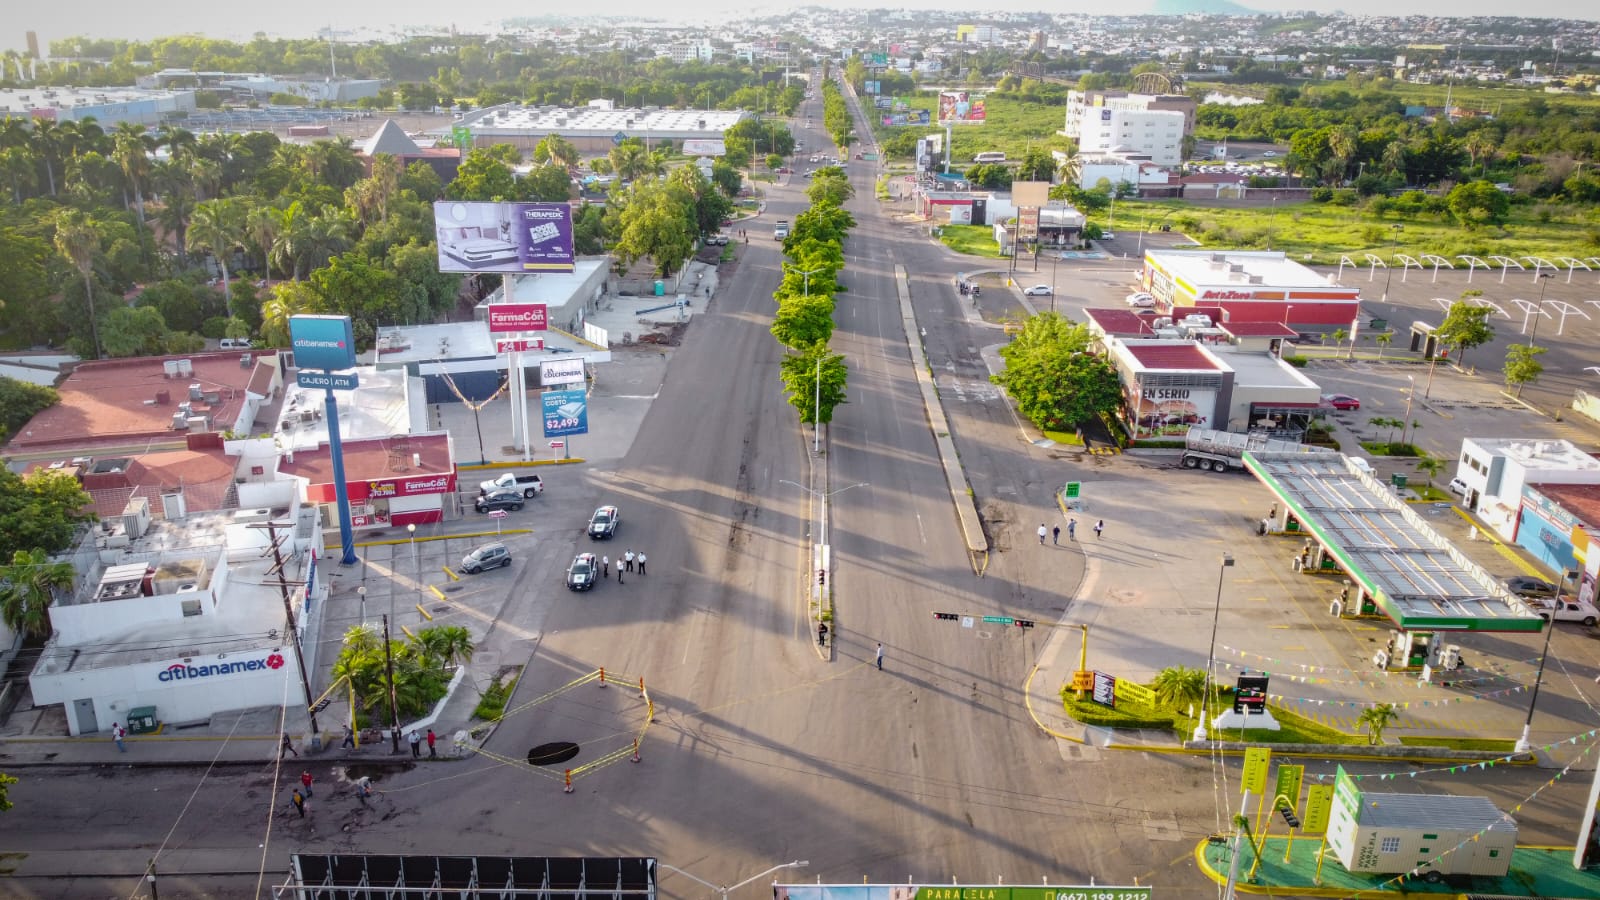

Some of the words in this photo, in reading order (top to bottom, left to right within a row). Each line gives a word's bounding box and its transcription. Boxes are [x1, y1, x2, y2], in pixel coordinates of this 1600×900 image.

[1202, 290, 1251, 300] AutoZone
[294, 338, 339, 348] citibanamex
[300, 377, 330, 385] CAJERO
[1143, 389, 1156, 399] EN
[1158, 389, 1190, 399] SERIO
[546, 418, 579, 429] $2,499
[158, 658, 267, 682] citibanamex
[927, 889, 994, 900] PARALELA
